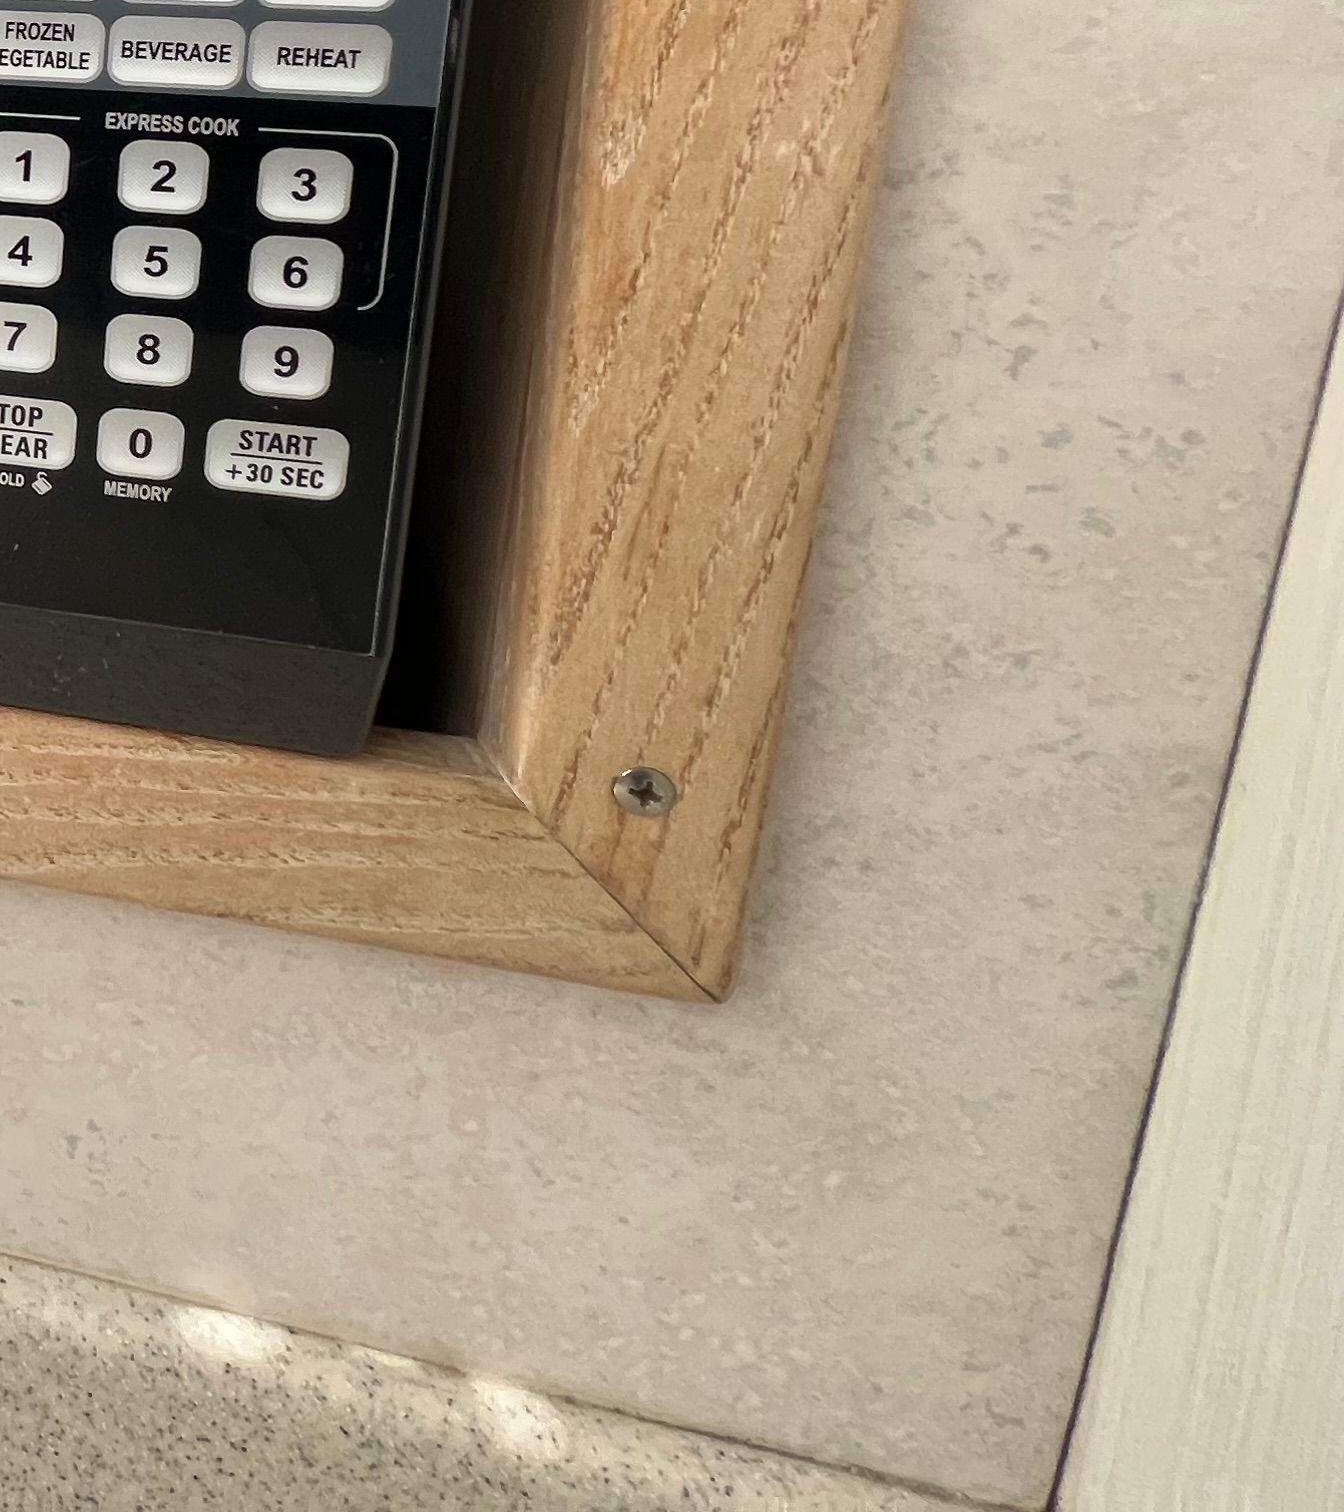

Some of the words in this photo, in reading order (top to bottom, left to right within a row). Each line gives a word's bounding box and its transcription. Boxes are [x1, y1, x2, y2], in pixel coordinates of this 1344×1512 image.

[5, 21, 75, 42] FROZEN
[120, 39, 233, 64] BEVERAGE
[276, 46, 362, 69] REHEAT
[104, 111, 184, 134] EXPRESS
[187, 116, 240, 137] COOK
[15, 149, 32, 182] 1
[150, 159, 177, 193] 2
[291, 168, 317, 202] 3
[7, 235, 33, 267] 4
[143, 245, 169, 278] 5
[282, 255, 309, 289] 6
[3, 320, 28, 352] 7
[136, 333, 161, 365] 8
[273, 345, 300, 378] 9
[128, 428, 153, 459] 0
[238, 429, 318, 457] START
[103, 478, 173, 503] MEMORY
[280, 466, 325, 489] SEC
